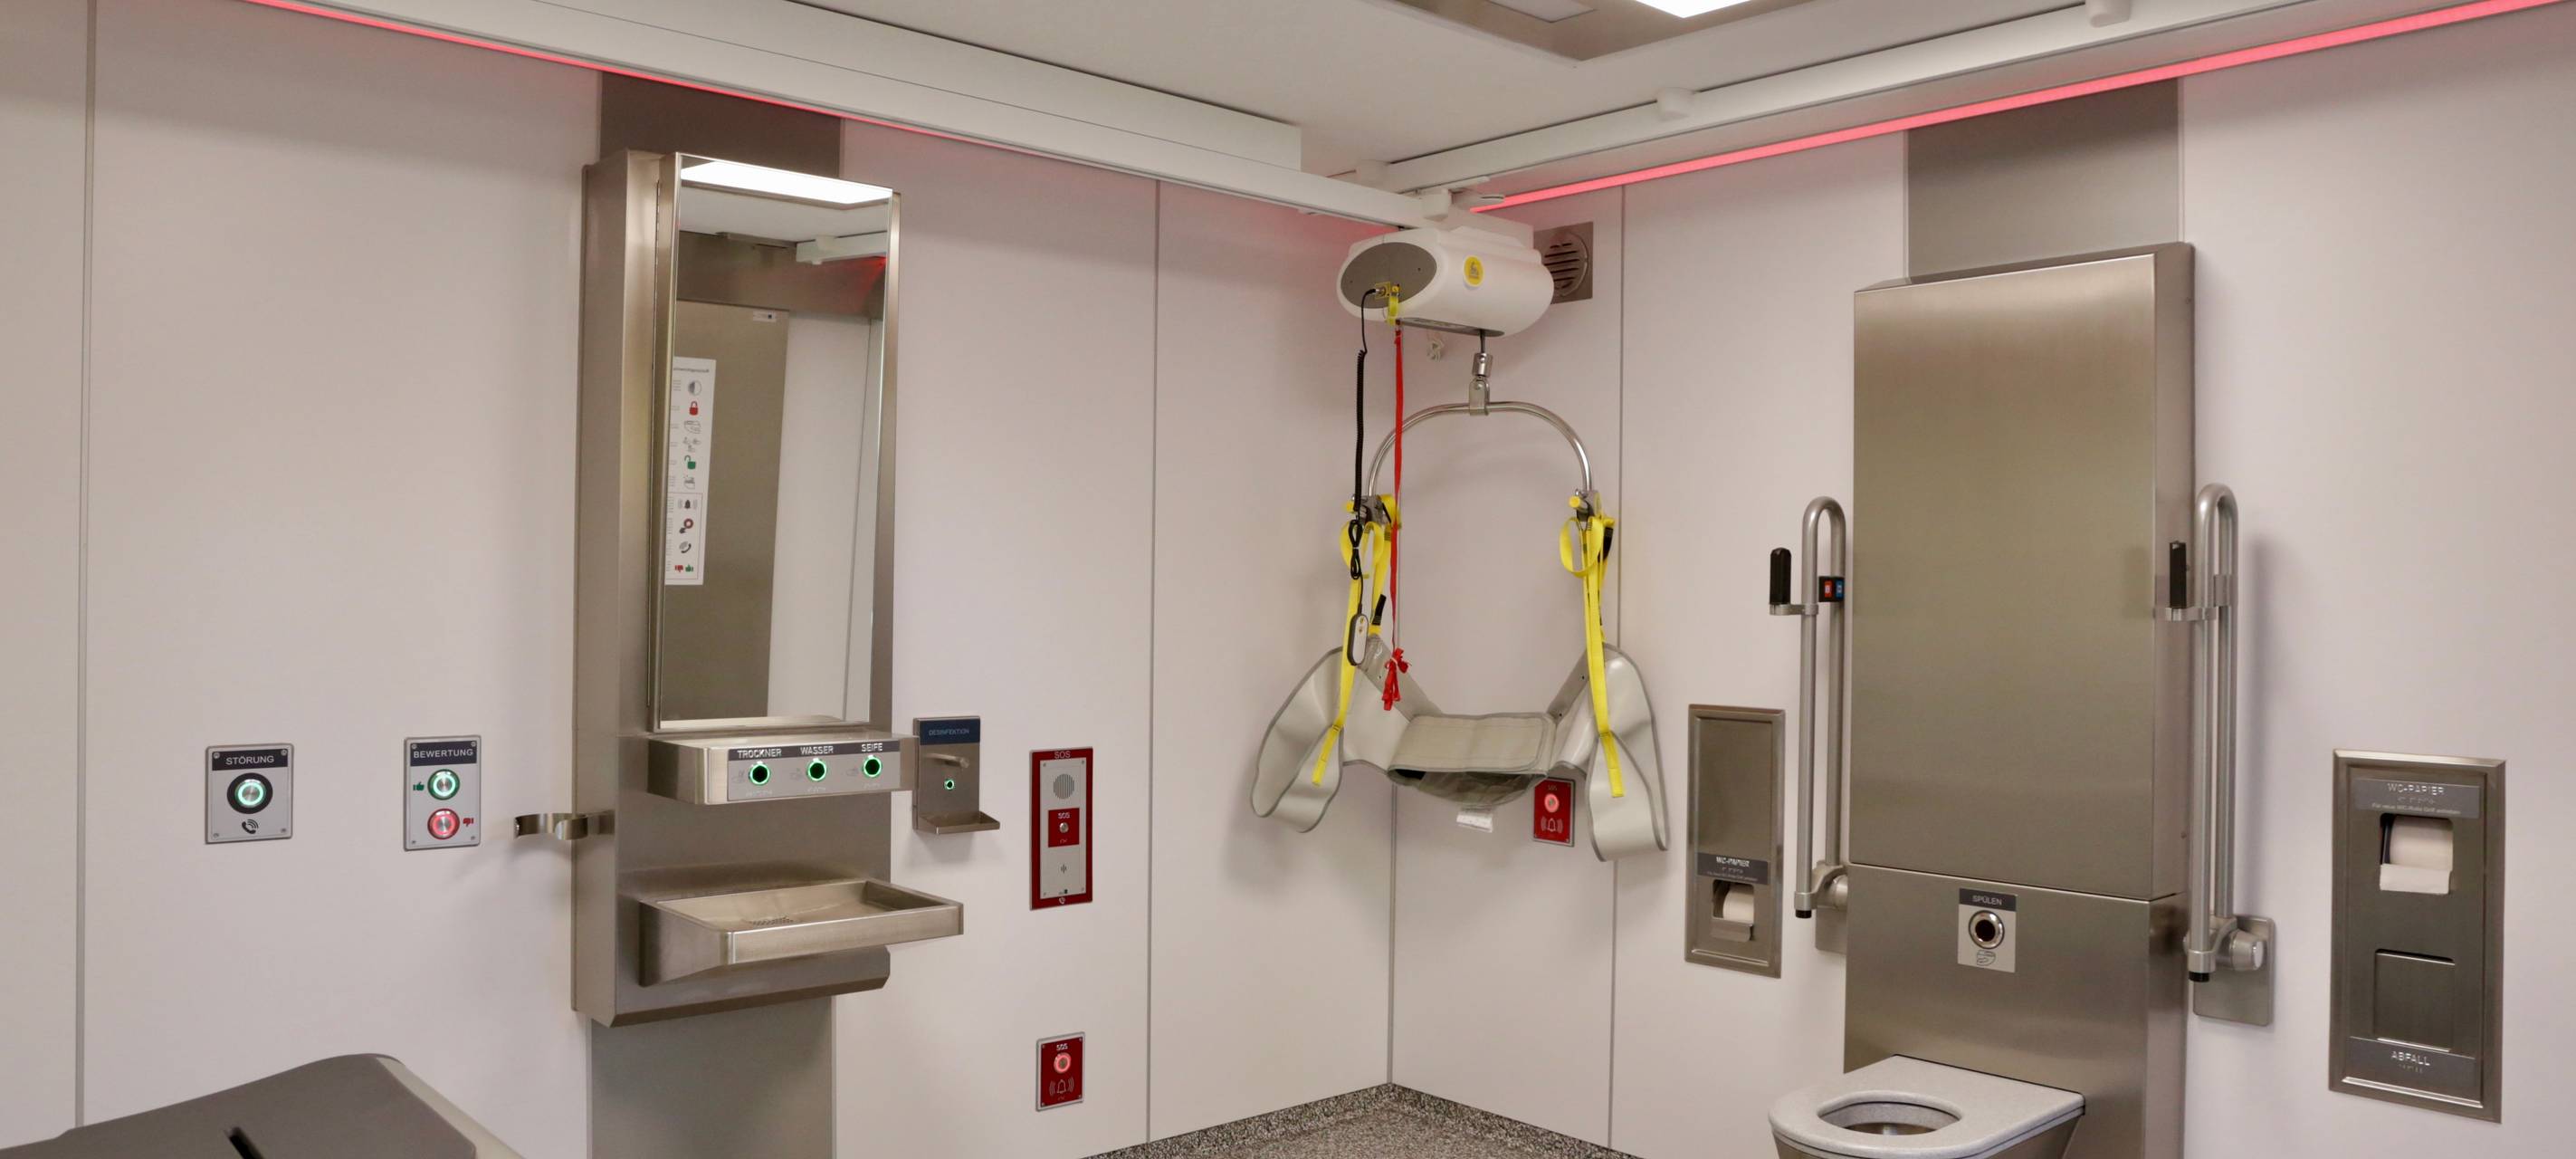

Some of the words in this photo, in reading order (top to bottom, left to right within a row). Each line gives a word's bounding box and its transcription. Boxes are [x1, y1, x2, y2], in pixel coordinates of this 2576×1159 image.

[800, 745, 834, 756] WASSER
[861, 742, 883, 752] SEIFE
[413, 748, 473, 759] BEWERTUNG
[737, 748, 782, 759] TROCKNER
[1054, 751, 1071, 759] SOS
[225, 754, 275, 765] STÖRUNG
[2387, 782, 2445, 796] WC-PAPIER
[1715, 856, 1751, 867] WC-PAPIER
[1972, 895, 2003, 906] SPÜLEN
[2390, 1050, 2430, 1066] ABFALL
